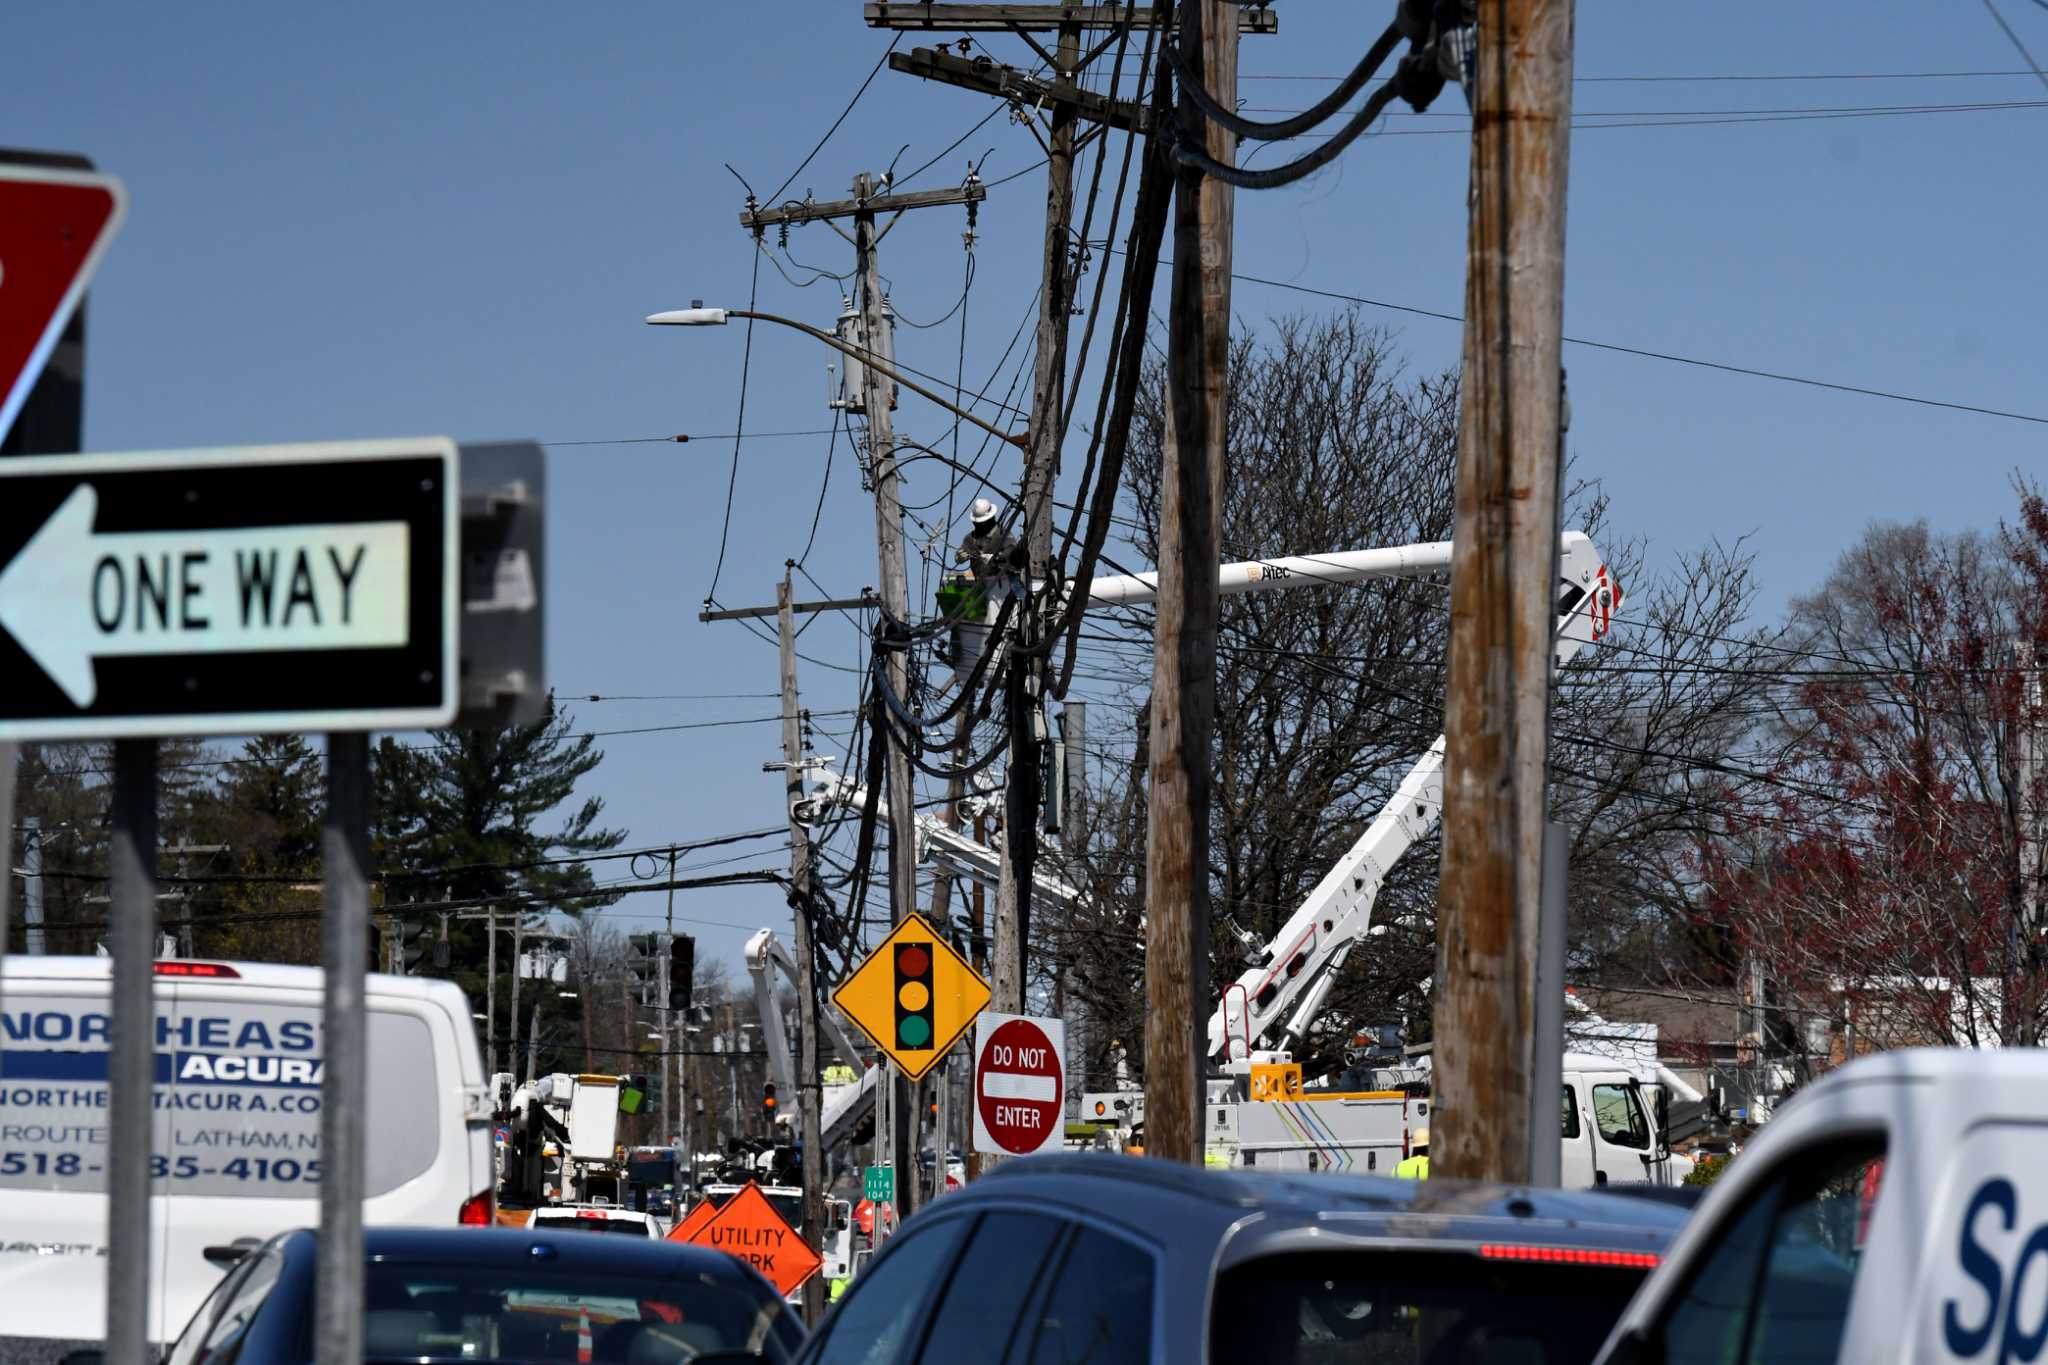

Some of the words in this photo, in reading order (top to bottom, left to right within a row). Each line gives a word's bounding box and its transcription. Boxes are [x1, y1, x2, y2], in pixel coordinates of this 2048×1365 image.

[92, 552, 209, 634] ONE
[235, 543, 366, 630] WAY
[0, 1012, 325, 1051] NORHEAS
[993, 1044, 1013, 1067] DO
[1018, 1047, 1047, 1070] NOT
[995, 1104, 1041, 1129] ENTER
[2, 1125, 108, 1144] ROUTE
[175, 1129, 293, 1150] LATHAM,
[297, 1134, 322, 1150] N
[0, 1153, 322, 1183] 518-85-4105
[711, 1227, 786, 1247] UTILITY
